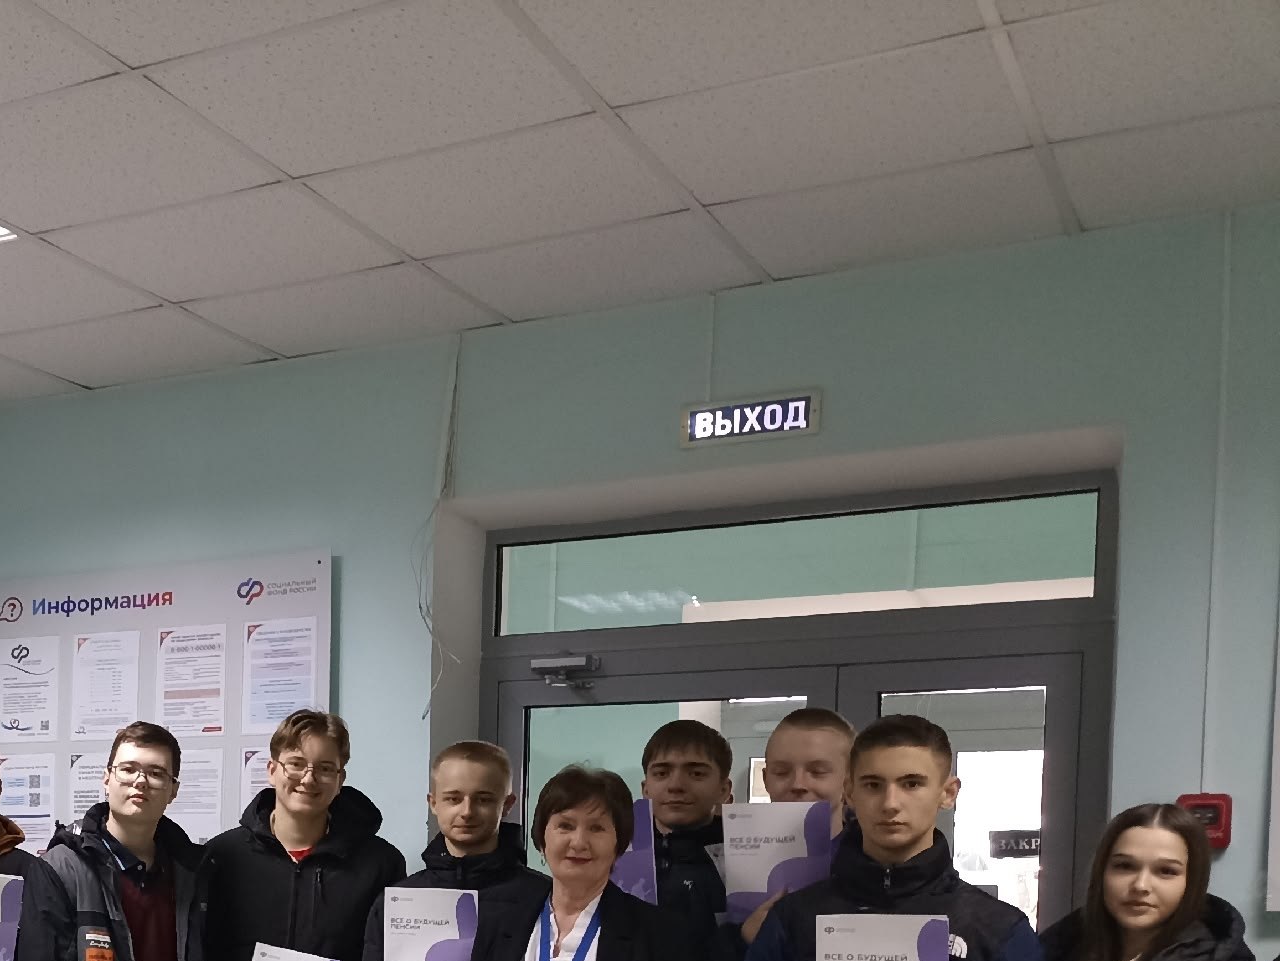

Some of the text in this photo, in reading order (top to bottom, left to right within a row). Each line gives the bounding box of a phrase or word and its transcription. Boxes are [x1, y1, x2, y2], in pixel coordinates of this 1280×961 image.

[694, 400, 807, 438] ВЫХОД
[267, 578, 317, 588] СОЦИАЛЬНЫЙ
[32, 591, 173, 617] Информация
[998, 838, 1040, 850] ЗАКР
[858, 954, 908, 961] БУДУЩЕЙ
